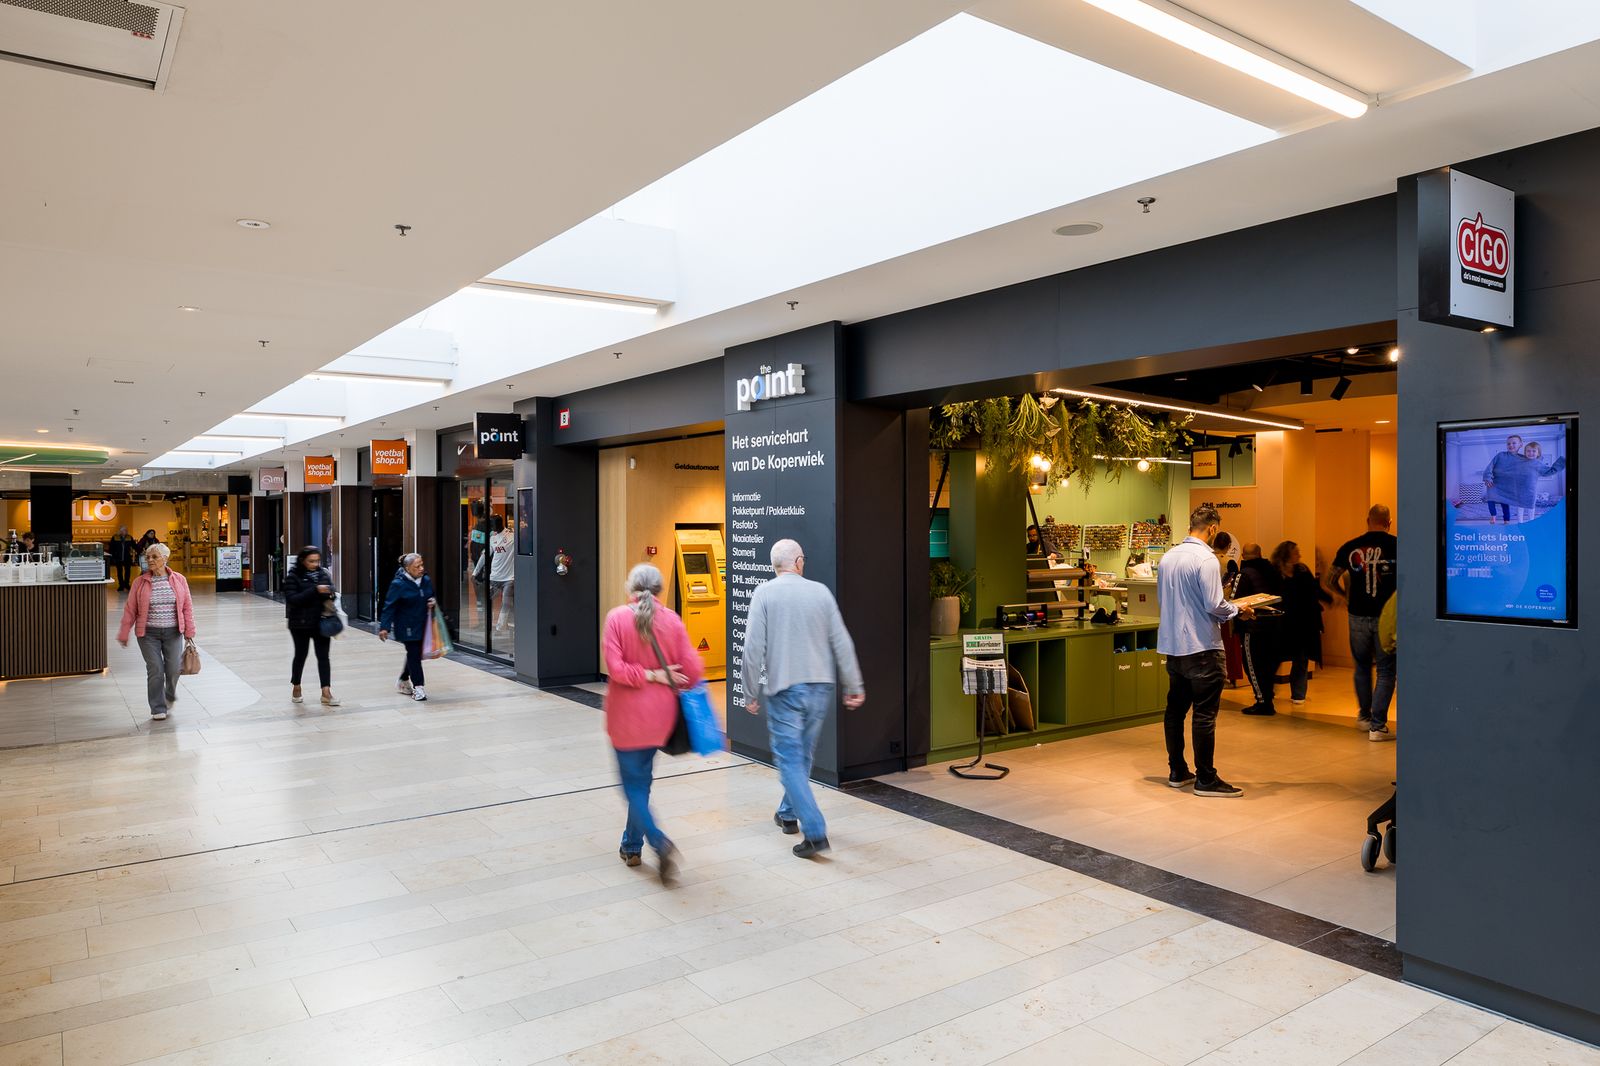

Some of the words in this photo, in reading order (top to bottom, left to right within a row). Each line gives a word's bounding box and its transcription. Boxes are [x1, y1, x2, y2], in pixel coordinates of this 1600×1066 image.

[1462, 227, 1506, 270] CIGO
[760, 364, 772, 374] the
[737, 363, 805, 411] point
[480, 430, 519, 444] point
[732, 435, 749, 450] Het
[751, 428, 808, 448] servicehart
[375, 449, 404, 457] voetbal
[375, 456, 404, 466] shop.nl
[732, 460, 749, 472] van
[752, 456, 765, 471] De
[768, 450, 825, 472] Koperwiek
[674, 463, 720, 471] Geldautomaat
[307, 469, 332, 477] shop.nl
[732, 492, 761, 502] Informatie
[732, 507, 765, 517] Pakketpunt
[732, 520, 758, 530] Pasfoto's
[732, 534, 764, 544] Naaiatelier
[1454, 533, 1476, 541] Snel
[1478, 533, 1497, 541] iets
[1500, 533, 1525, 542] laten
[1454, 543, 1508, 552] vermaken?
[732, 547, 756, 559] Stomerij
[1454, 553, 1465, 561] Zo
[1467, 554, 1497, 563] gefikst
[1500, 554, 1511, 564] bij
[732, 575, 744, 584] DHL
[732, 588, 745, 598] Max
[732, 615, 749, 626] Gevo
[732, 629, 746, 640] Cop
[732, 642, 744, 653] Pow
[732, 696, 746, 708] EHB
